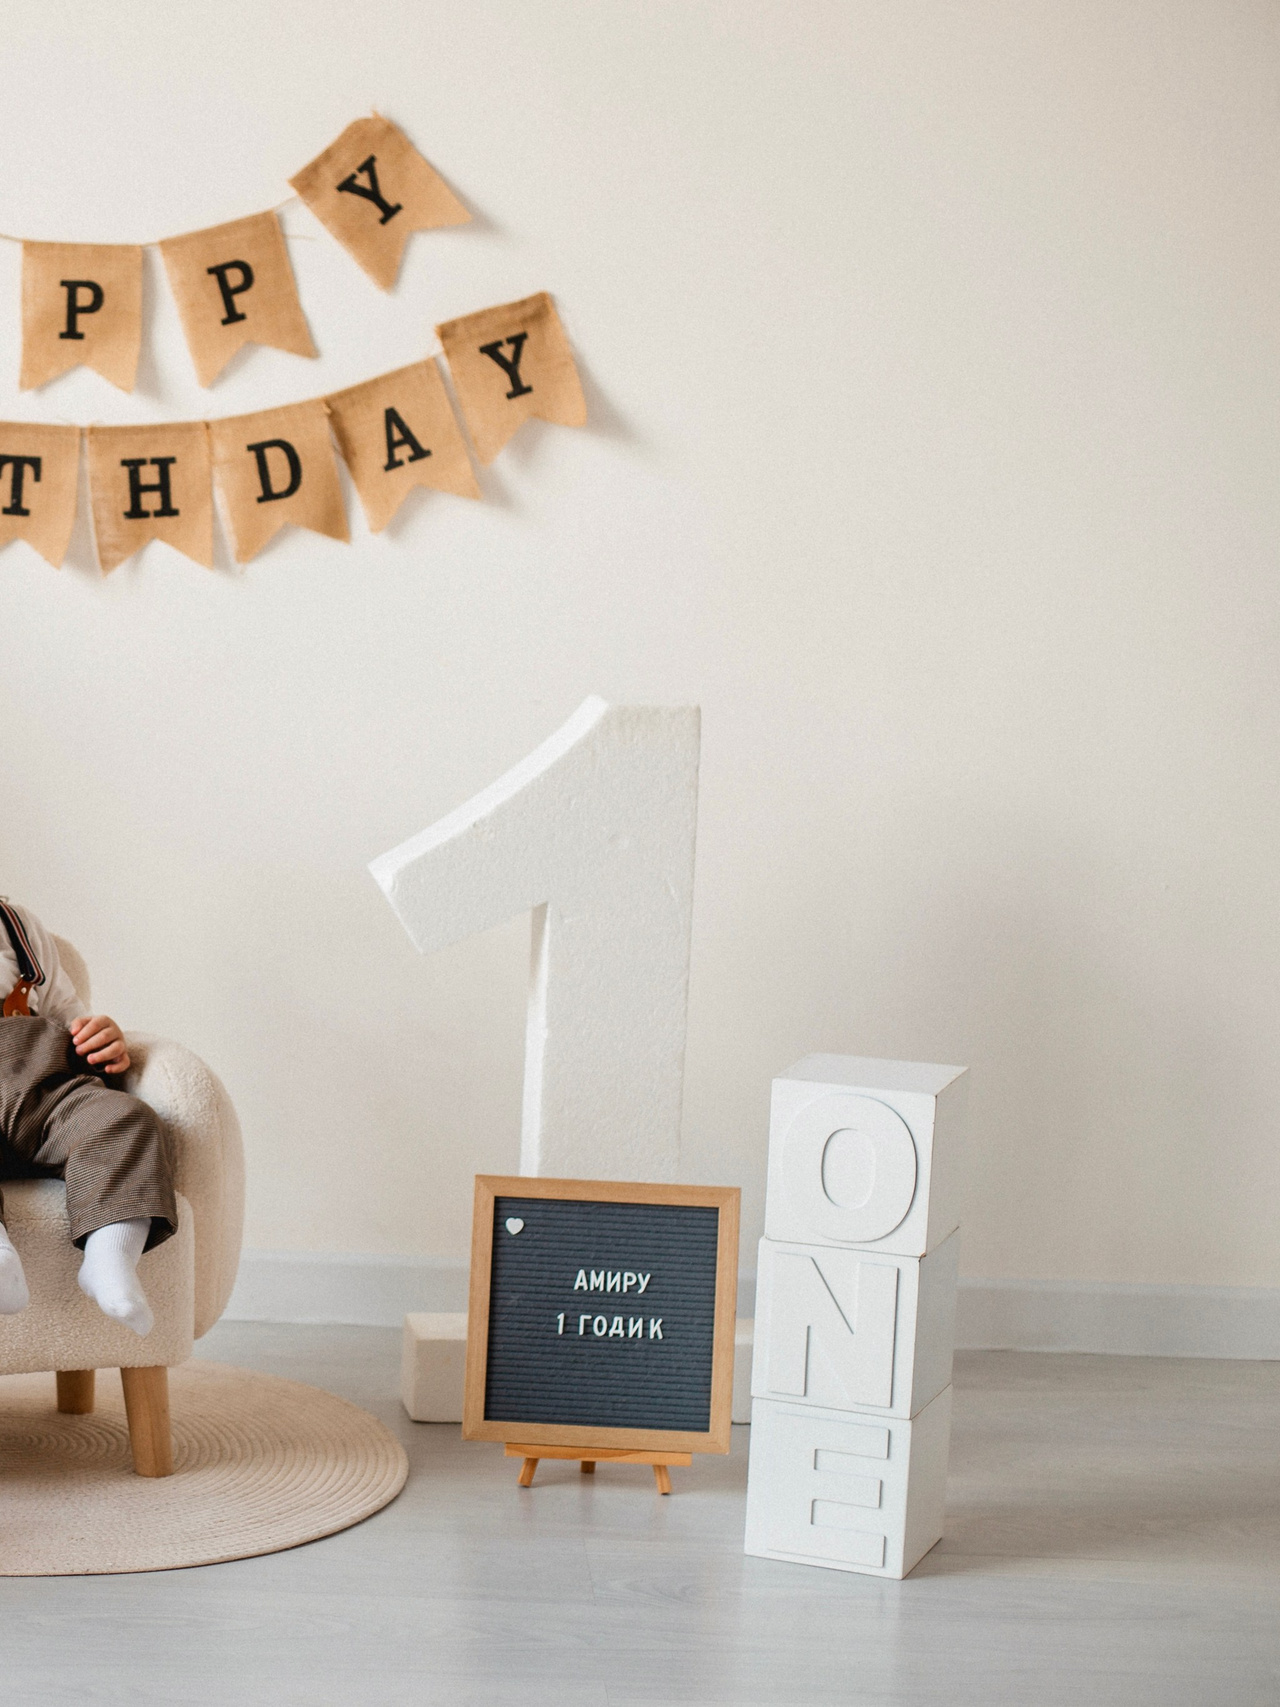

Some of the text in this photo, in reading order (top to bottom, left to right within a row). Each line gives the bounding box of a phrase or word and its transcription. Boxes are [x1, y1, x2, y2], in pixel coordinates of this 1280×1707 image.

[573, 1269, 651, 1294] АМИРУ
[556, 1312, 663, 1340] 1 ГОДИК
[764, 1092, 918, 1568] ONE
